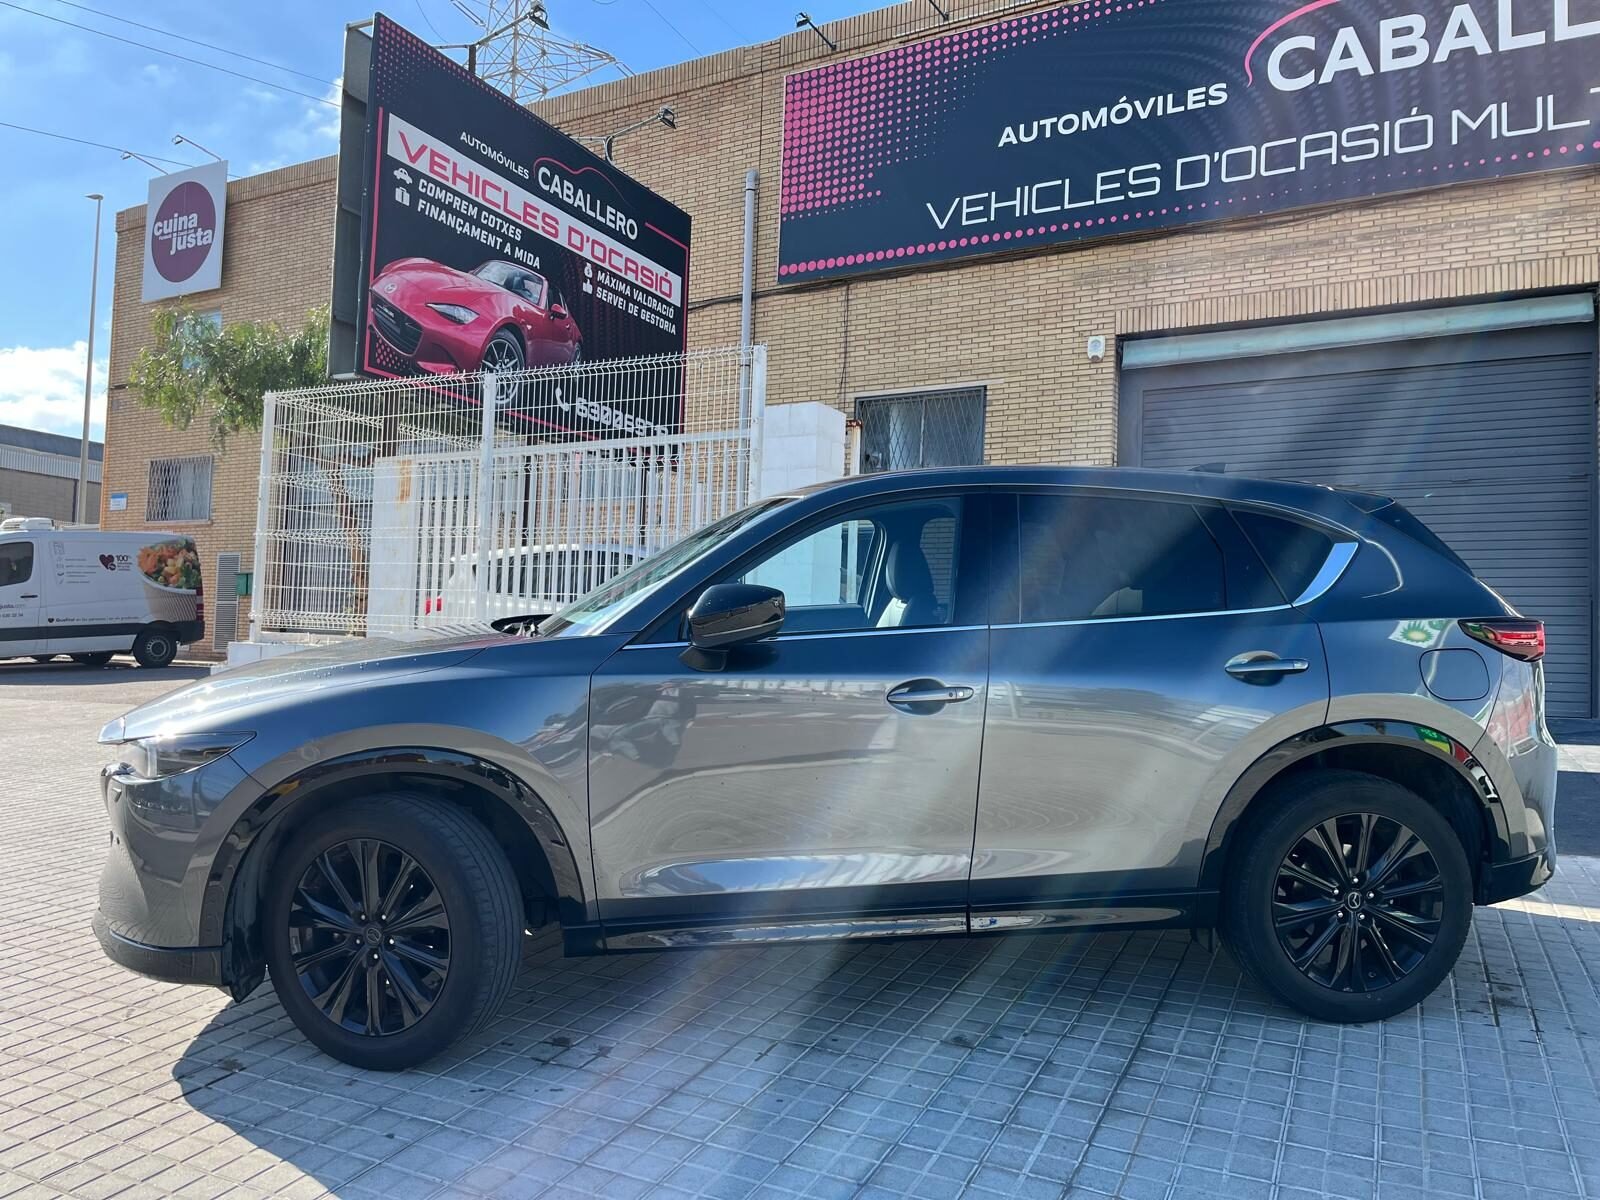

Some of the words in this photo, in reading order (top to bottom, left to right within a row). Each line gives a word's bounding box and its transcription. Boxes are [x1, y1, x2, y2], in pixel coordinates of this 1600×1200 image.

[998, 83, 1228, 147] AUTOMÓVILES
[460, 131, 530, 180] AUTOMÓVILES
[538, 166, 638, 240] CABALLERO
[926, 163, 1162, 230] VEHICLES
[1176, 107, 1434, 192] D'OCASIÓ
[1451, 87, 1600, 146] MUL
[153, 212, 198, 237] cuina
[398, 130, 560, 239] VEHICLES
[567, 224, 673, 300] D'OCASIÓ
[417, 198, 503, 250] FINANÇAMENT
[504, 242, 512, 256] A
[514, 247, 541, 270] MIDA
[418, 178, 478, 219] COMPREM
[480, 210, 522, 241] COTXES
[170, 227, 213, 256] justa
[596, 286, 626, 311] SERVEI
[627, 302, 640, 317] DE
[640, 308, 677, 336] GESTORIA
[597, 270, 631, 296] MÀXIMA
[633, 288, 674, 319] VALORACIÓ
